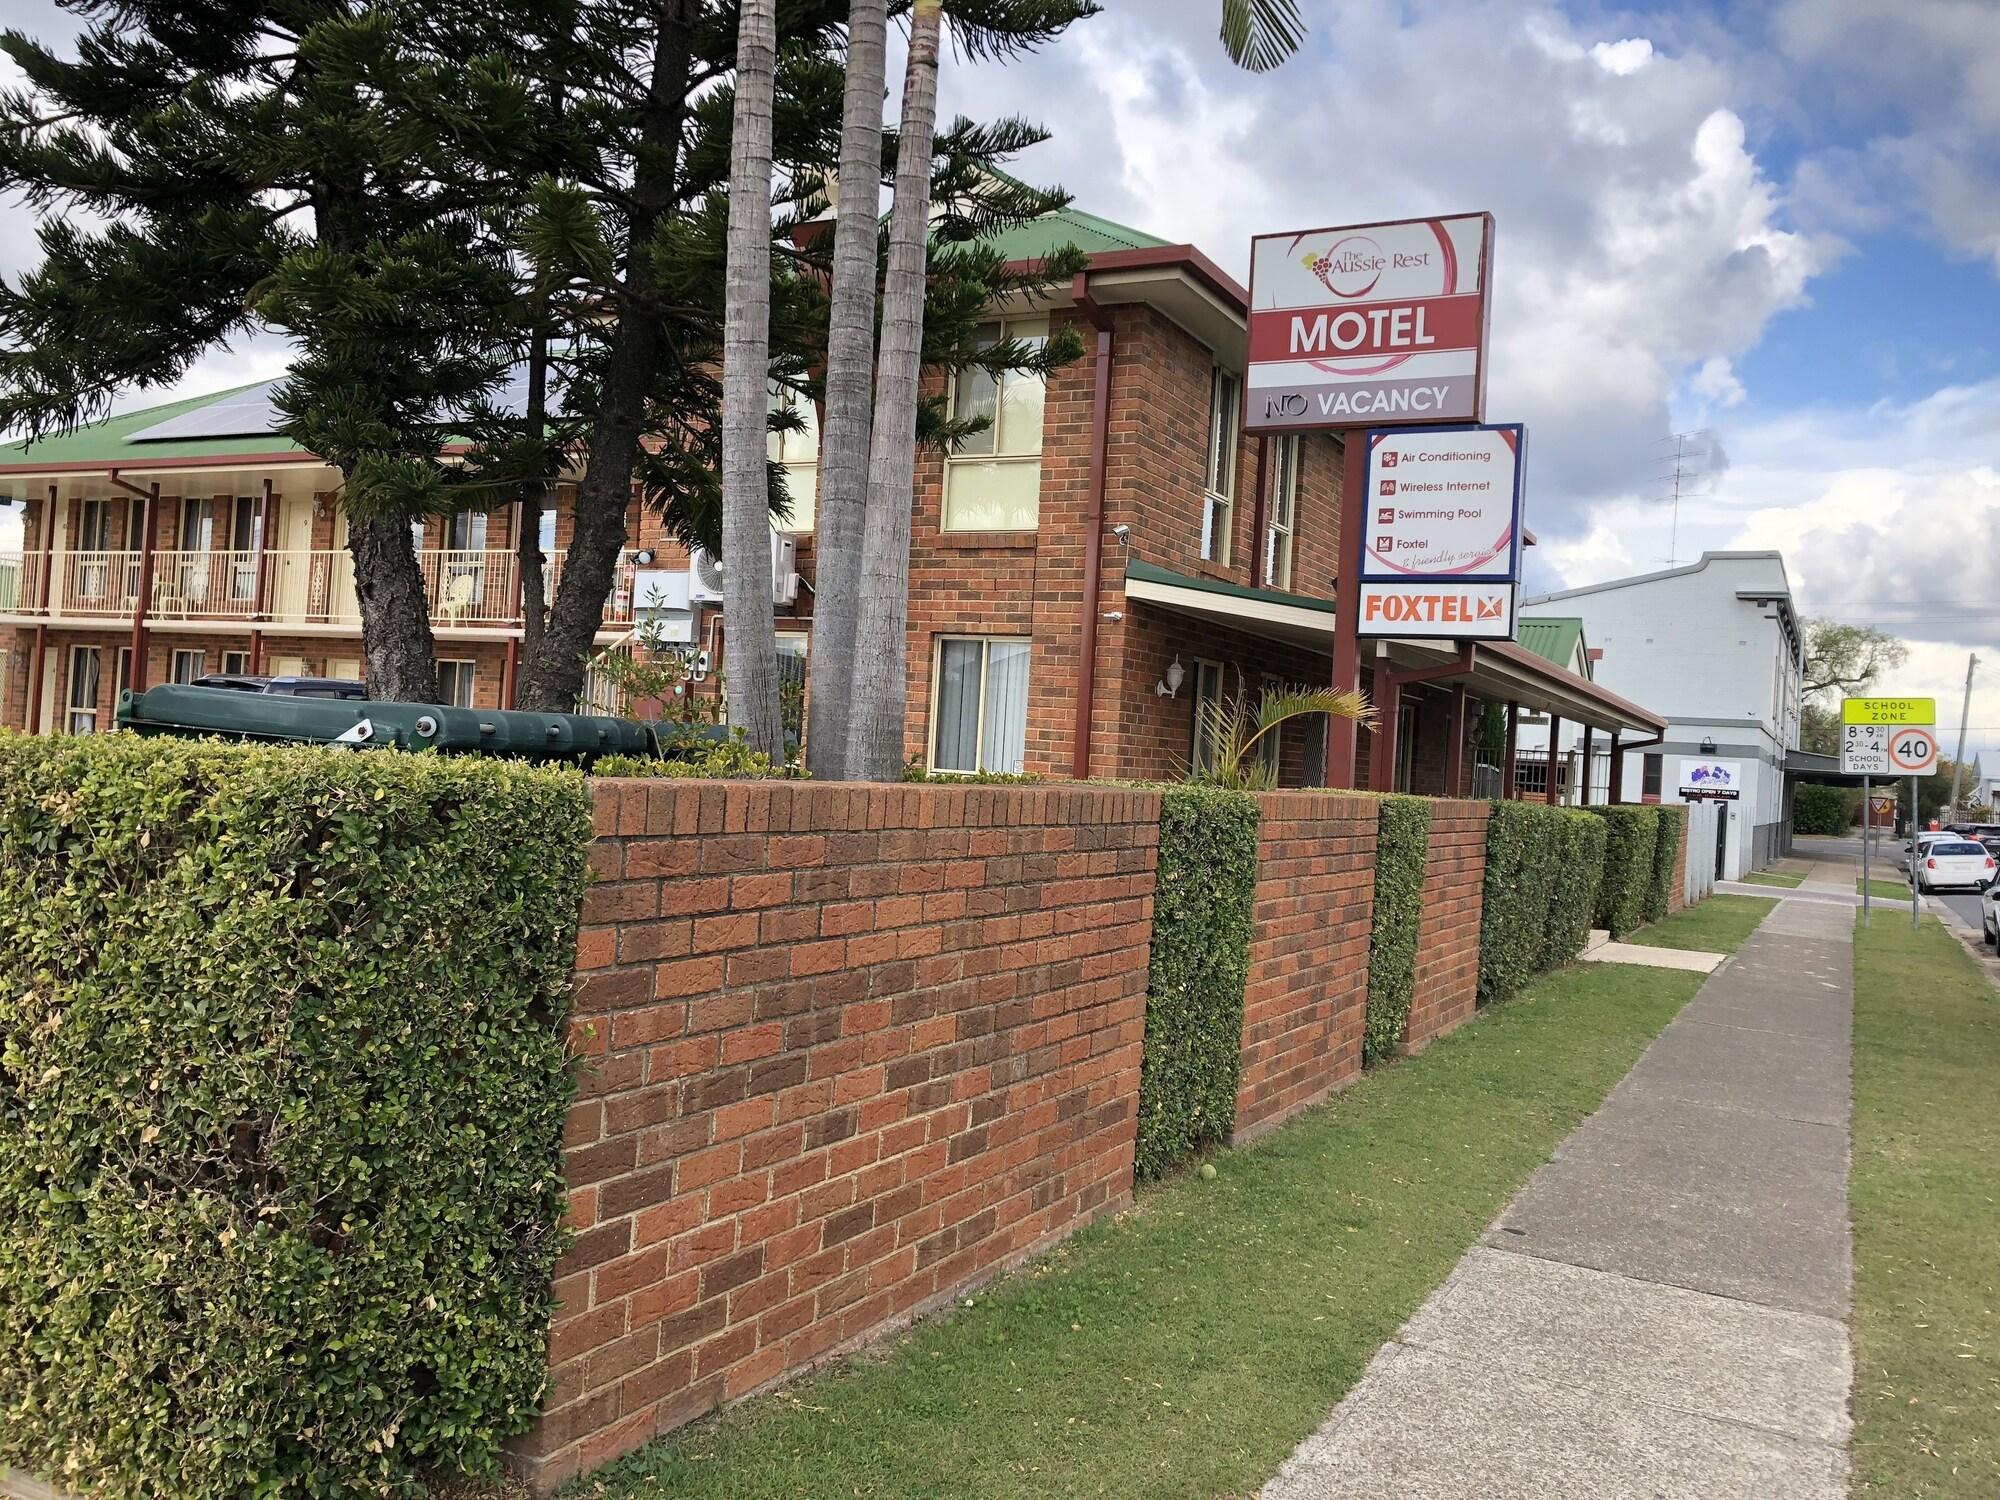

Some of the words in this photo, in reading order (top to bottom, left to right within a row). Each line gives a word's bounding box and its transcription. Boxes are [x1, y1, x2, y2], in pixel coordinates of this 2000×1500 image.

[1342, 251, 1363, 262] The
[1331, 256, 1387, 274] Aussie
[1393, 252, 1431, 269] Rest
[1289, 306, 1435, 353] MOTEL
[1266, 394, 1308, 418] NO
[1317, 386, 1450, 415] VACANCY
[1401, 453, 1415, 463] Air
[1418, 452, 1491, 463] Conditioning
[1400, 482, 1443, 492] Wireless
[1446, 481, 1490, 491] Internet
[1398, 509, 1454, 520] Swimming
[1458, 509, 1482, 519] Pool
[1396, 539, 1428, 549] Foxtel
[1411, 549, 1456, 569] friendly
[1366, 594, 1473, 622] FOXTEL
[1864, 702, 1914, 710] SCHOOL
[1872, 712, 1907, 720] ZONE
[1898, 740, 1928, 758] 40
